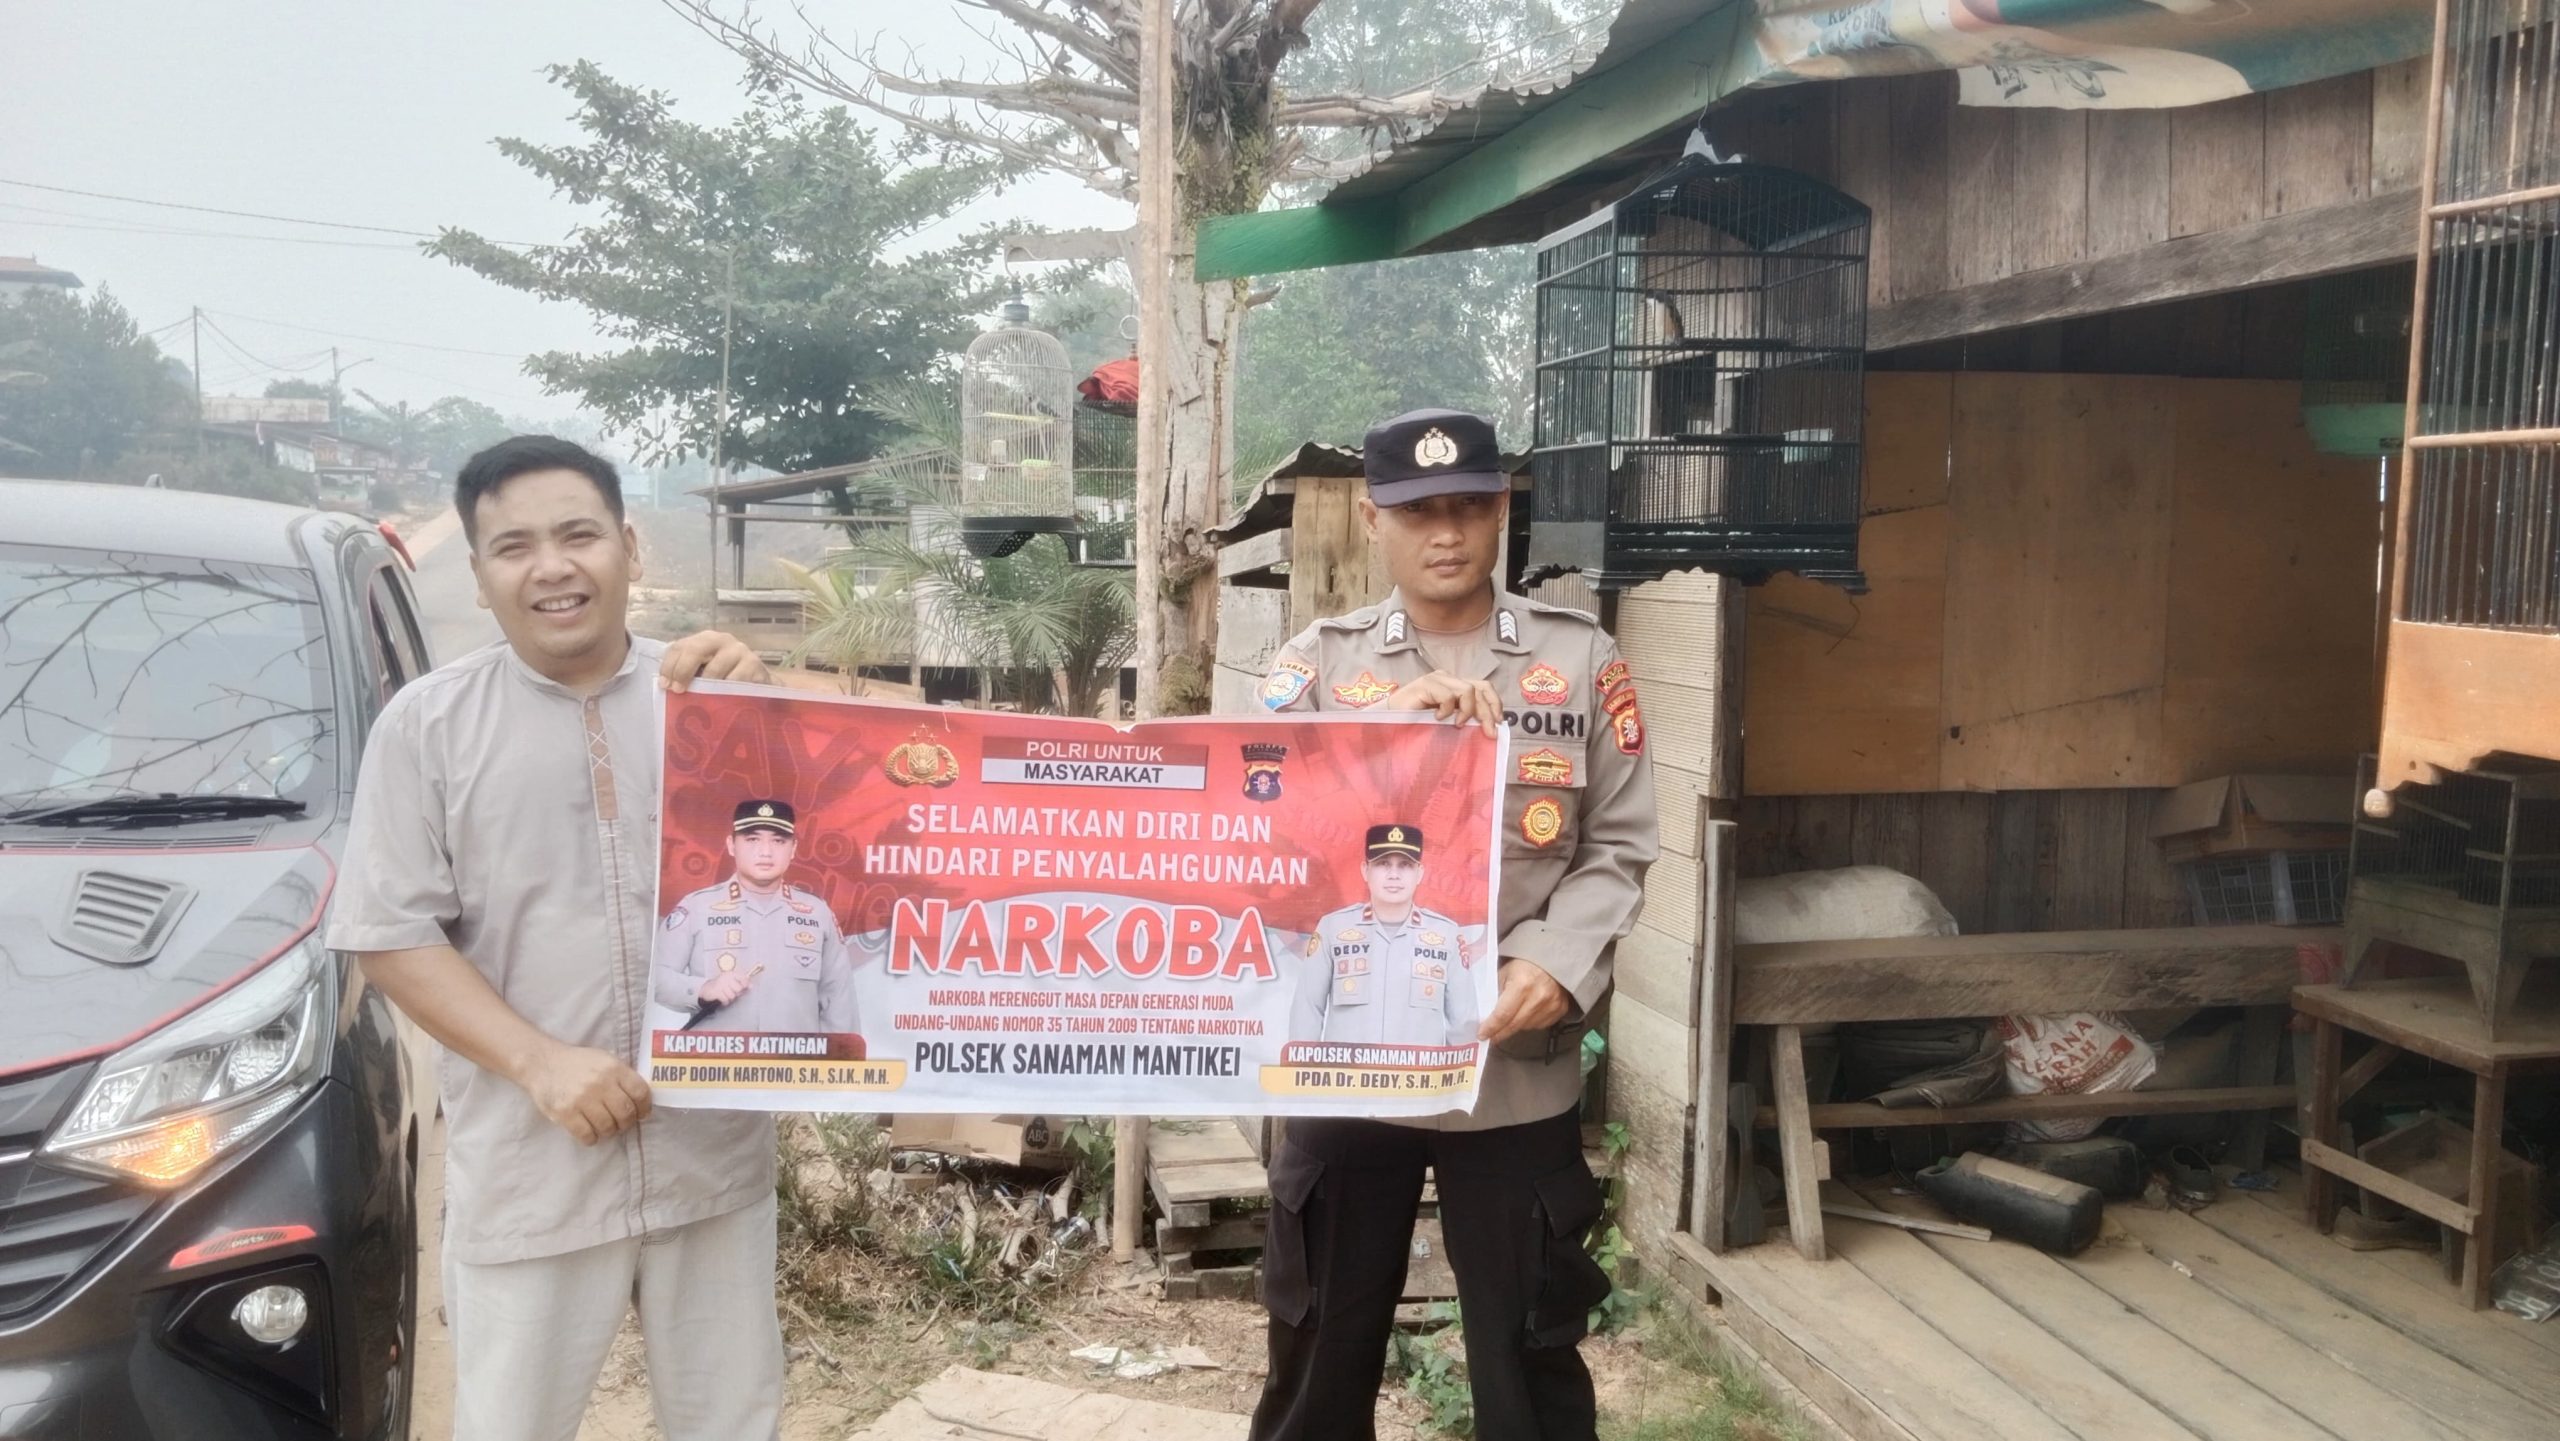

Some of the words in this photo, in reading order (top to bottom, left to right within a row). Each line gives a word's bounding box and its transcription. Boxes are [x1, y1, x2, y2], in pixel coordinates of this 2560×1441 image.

[1503, 710, 1585, 738] POLRI
[1026, 741, 1088, 759] POLRI
[1094, 744, 1164, 762] UNTUK
[1024, 762, 1164, 784] MASYARAKAT
[908, 803, 1125, 838] SELAMATKAN
[1136, 811, 1201, 841] DIRI
[1211, 813, 1271, 844] DAN
[865, 844, 1000, 875] HINDARI
[1012, 848, 1308, 885] PENYALAHGUNAAN
[707, 915, 742, 926] DODIK
[787, 915, 820, 929] POLRI
[888, 897, 1278, 982] NARKOBA
[1334, 943, 1371, 957] DEDY
[1414, 947, 1448, 962] POLRI
[929, 990, 986, 1007] NARKOBA
[989, 991, 1062, 1008] MERENGGUT
[1065, 992, 1097, 1009] MASA
[1100, 993, 1140, 1010] DEPAN
[1142, 993, 1199, 1011] GENERASI
[1201, 994, 1234, 1011] MUDA
[894, 1014, 1000, 1031] UNDANG-UNDANG
[1002, 1015, 1044, 1032] NOMOR
[1047, 1016, 1063, 1032] 35
[1066, 1017, 1106, 1034] TAHUN
[1108, 1018, 1137, 1034] 2009
[1141, 1018, 1196, 1036] TENTANG
[1198, 1019, 1264, 1037] NARKOTIKA
[664, 1034, 744, 1054] KAPOLRES
[748, 1036, 828, 1055] KATINGAN
[915, 1041, 1007, 1074] POLSEK
[1013, 1043, 1125, 1076] SANAMAN
[1133, 1045, 1240, 1077] MANTIKEI
[1288, 1046, 1352, 1065] KAPOLSEK
[1354, 1048, 1417, 1066] SANAMAN
[1419, 1046, 1475, 1067] MANTIKEI
[651, 1064, 687, 1082] AKBP
[690, 1065, 730, 1083] DODIK
[733, 1066, 796, 1085] HARTONO,
[863, 1069, 889, 1085] M.H.
[1295, 1070, 1331, 1088] IPDA
[1335, 1071, 1356, 1088] Dr.
[1360, 1071, 1401, 1090] DEDY,
[1441, 1069, 1469, 1088] M.H.
[1028, 1129, 1048, 1142] ABC
